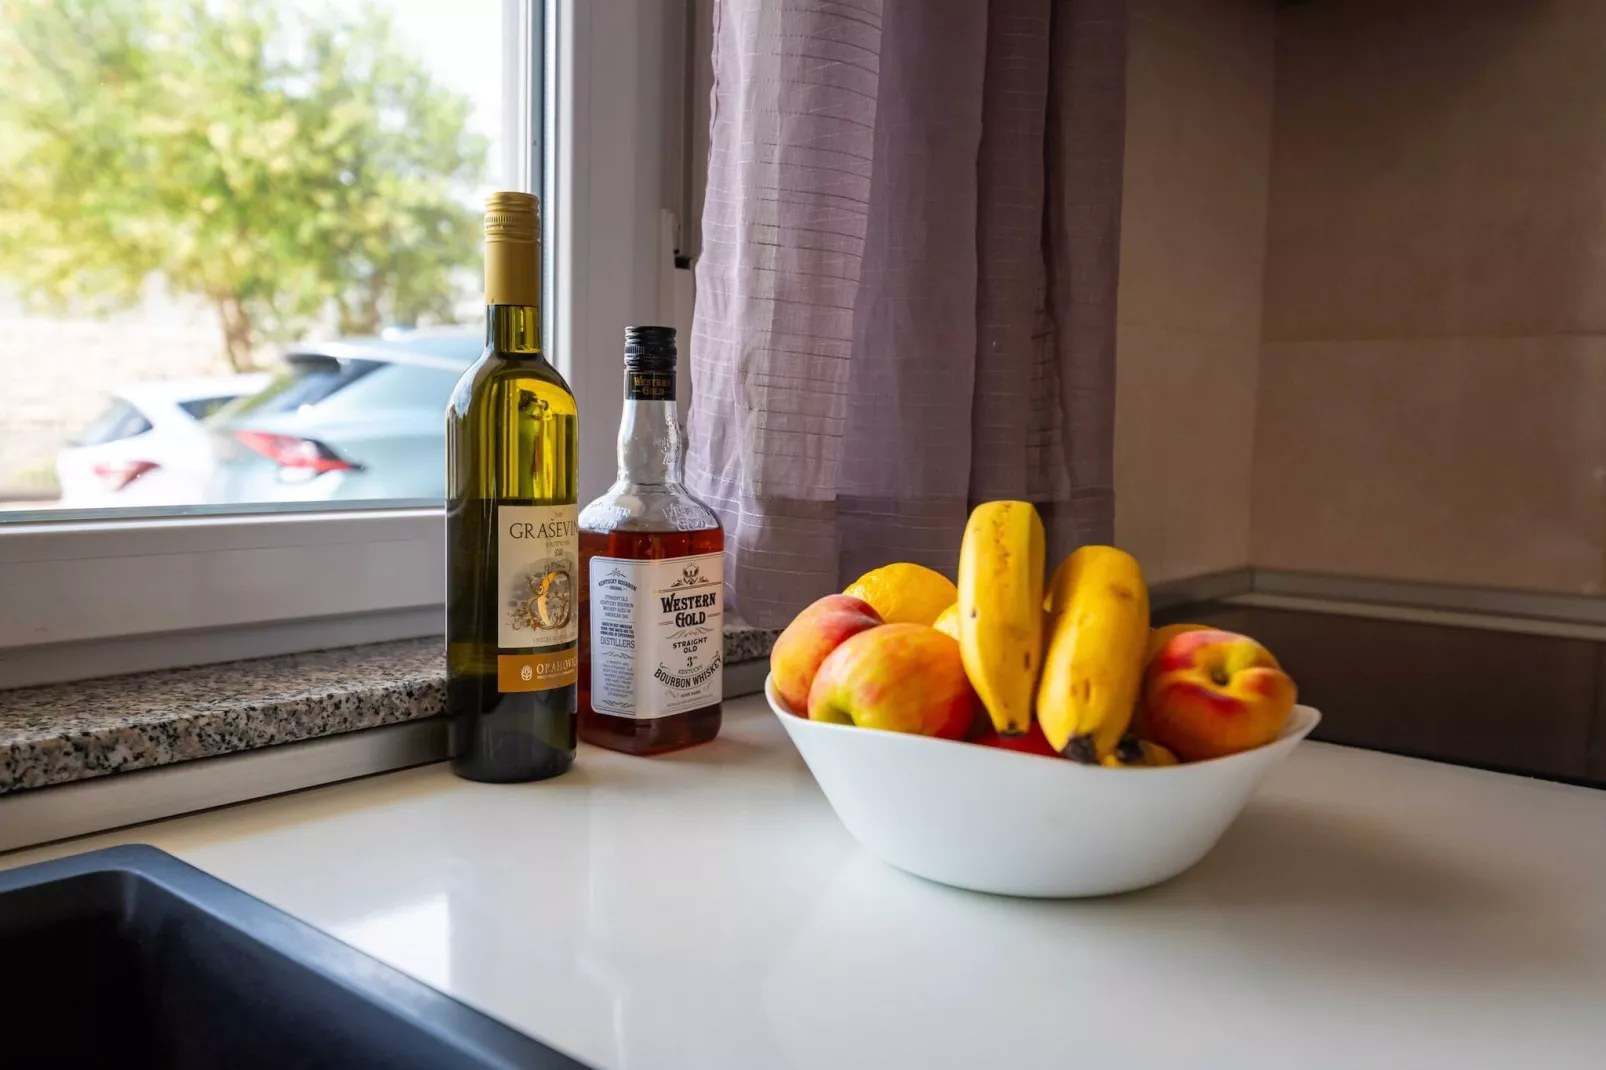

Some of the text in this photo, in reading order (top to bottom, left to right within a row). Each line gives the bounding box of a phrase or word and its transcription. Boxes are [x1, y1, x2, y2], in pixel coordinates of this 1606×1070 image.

[660, 592, 717, 614] WESTERN
[675, 611, 706, 628] GOLD
[600, 635, 636, 649] DISTILLERS
[672, 636, 708, 649] STRAIGHT
[683, 645, 698, 654] OLD
[654, 655, 722, 688] BOURBON WHISKEY
[677, 665, 703, 675] KENTUCKY
